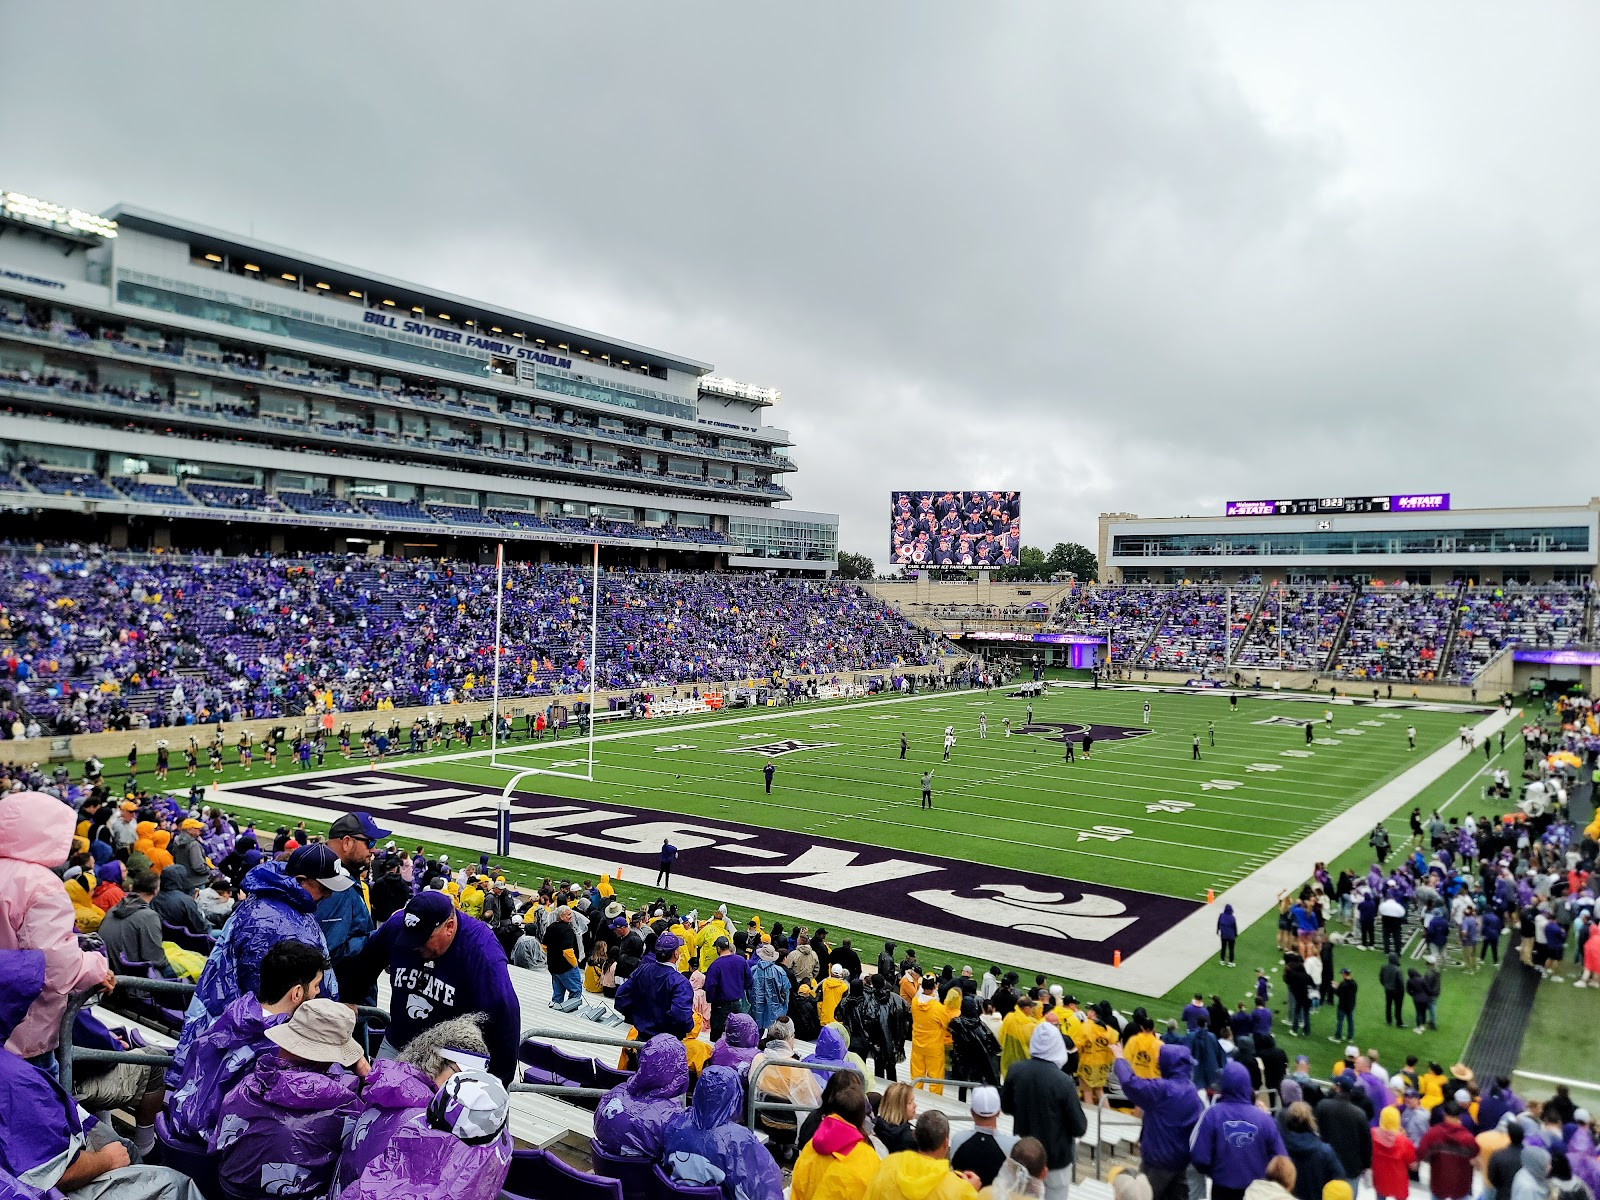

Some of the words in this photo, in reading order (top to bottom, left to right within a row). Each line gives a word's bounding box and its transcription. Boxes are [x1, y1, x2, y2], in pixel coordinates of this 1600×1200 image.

[363, 310, 397, 329] BILL
[402, 321, 461, 344] SNYDER
[466, 335, 514, 356] FAMILY
[516, 347, 572, 370] STADIUM
[1398, 495, 1443, 506] K-STATE
[1227, 506, 1273, 515] K-STATE!
[262, 776, 948, 892] K-STATE
[1076, 825, 1134, 842] 10
